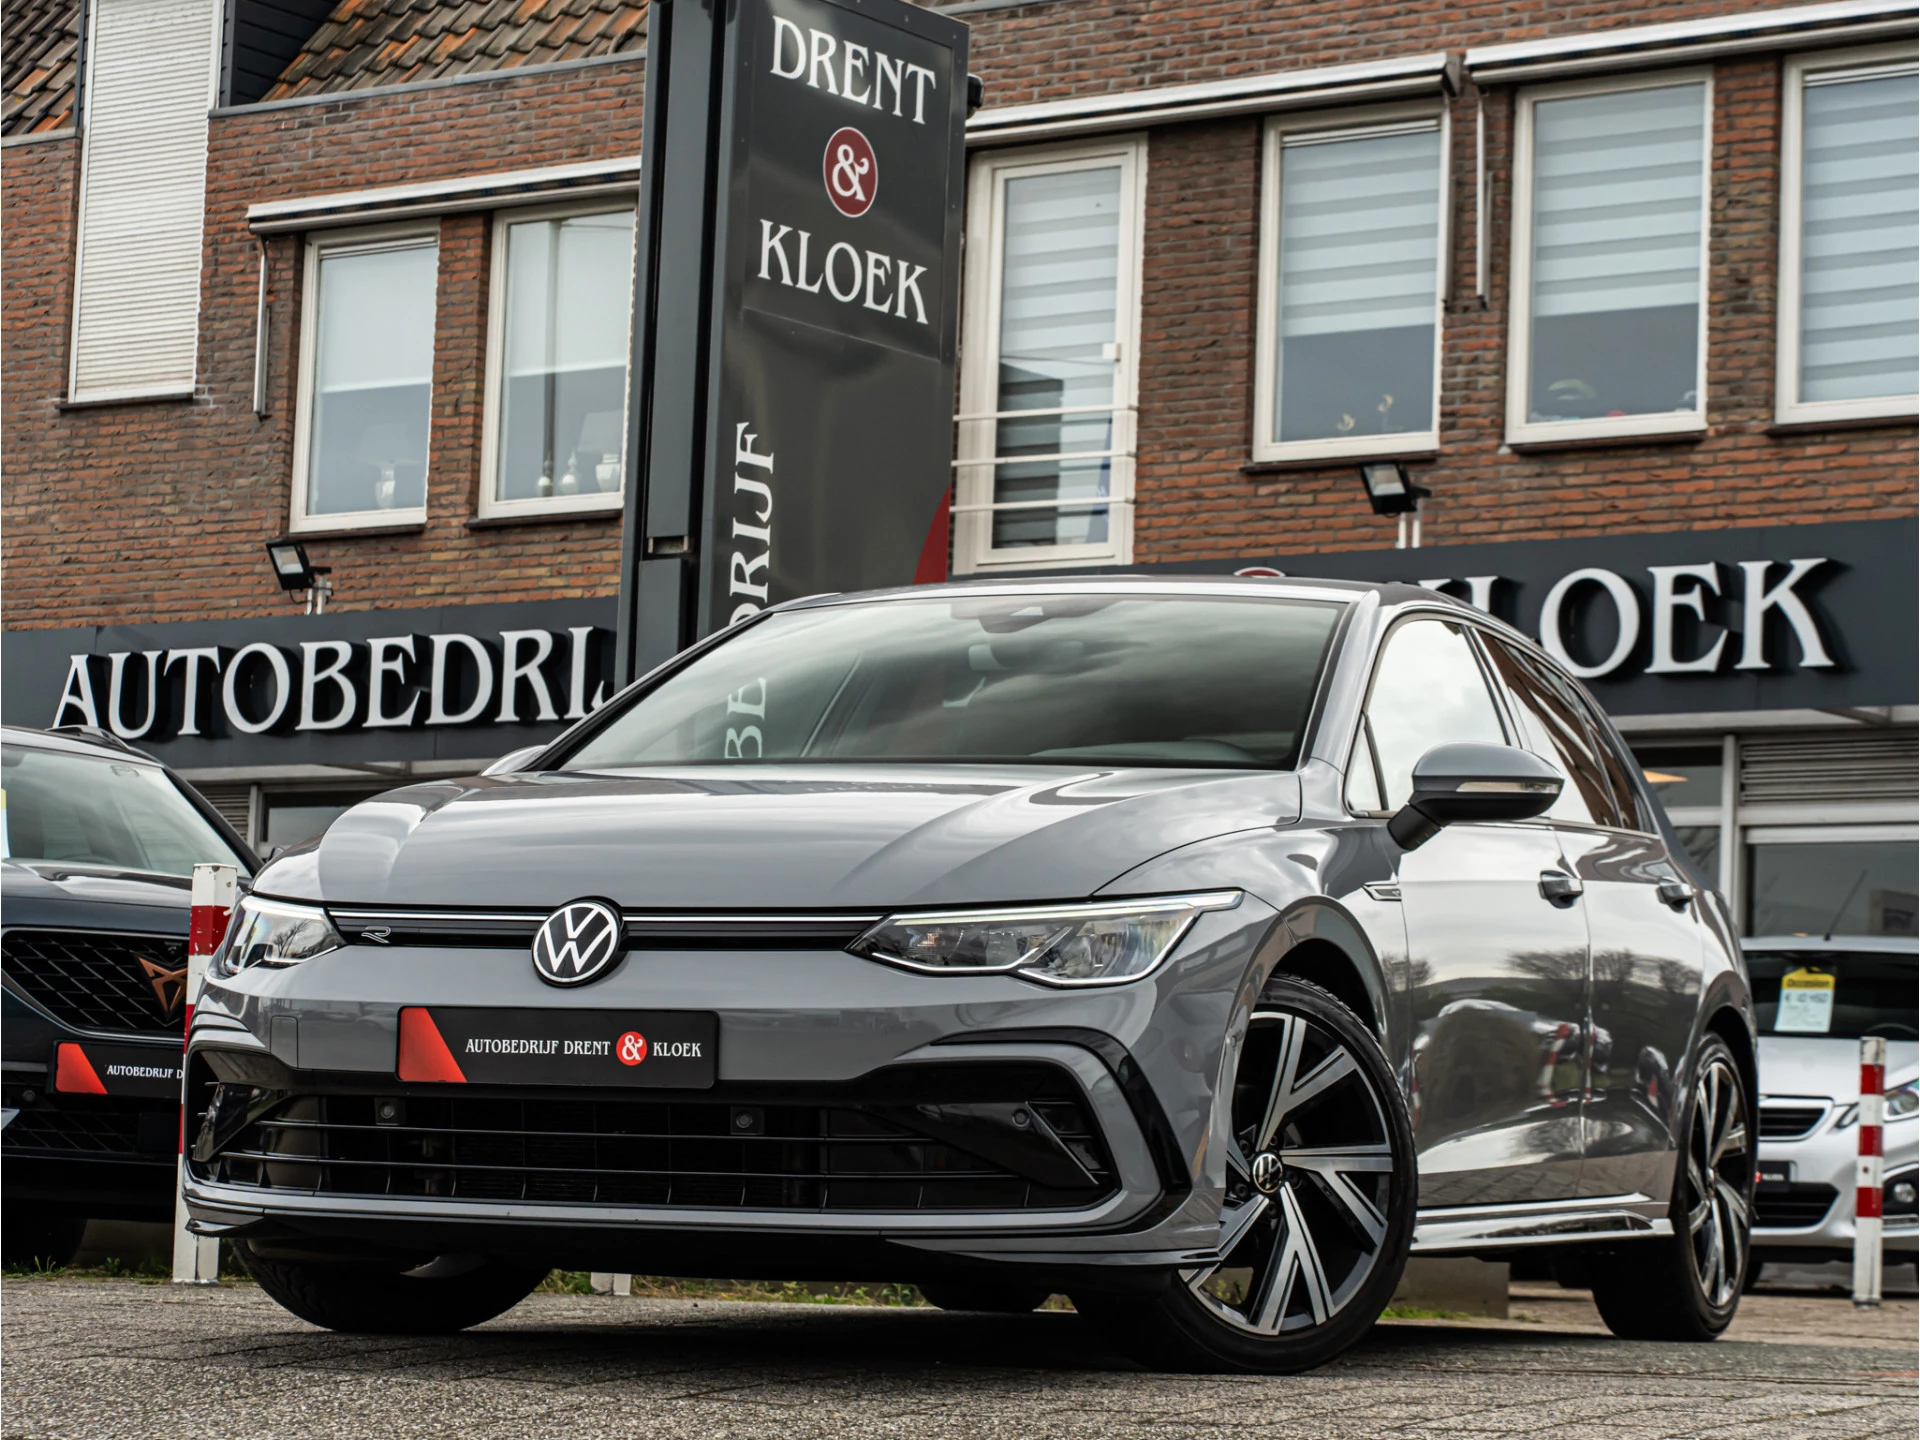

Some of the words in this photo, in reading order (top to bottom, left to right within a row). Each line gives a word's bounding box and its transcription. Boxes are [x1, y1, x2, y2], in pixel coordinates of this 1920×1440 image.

[770, 15, 936, 125] DRENT
[832, 144, 869, 201] &
[757, 218, 929, 324] KLOEK
[54, 627, 604, 739] AUTOBEDRI
[361, 926, 391, 944] R
[106, 1065, 173, 1078] AUTOBEDRIJF
[466, 1038, 559, 1055] AUTOBEDRIJF
[564, 1040, 611, 1056] DRENT
[622, 1035, 643, 1060] &
[653, 1042, 702, 1058] KLOEK
